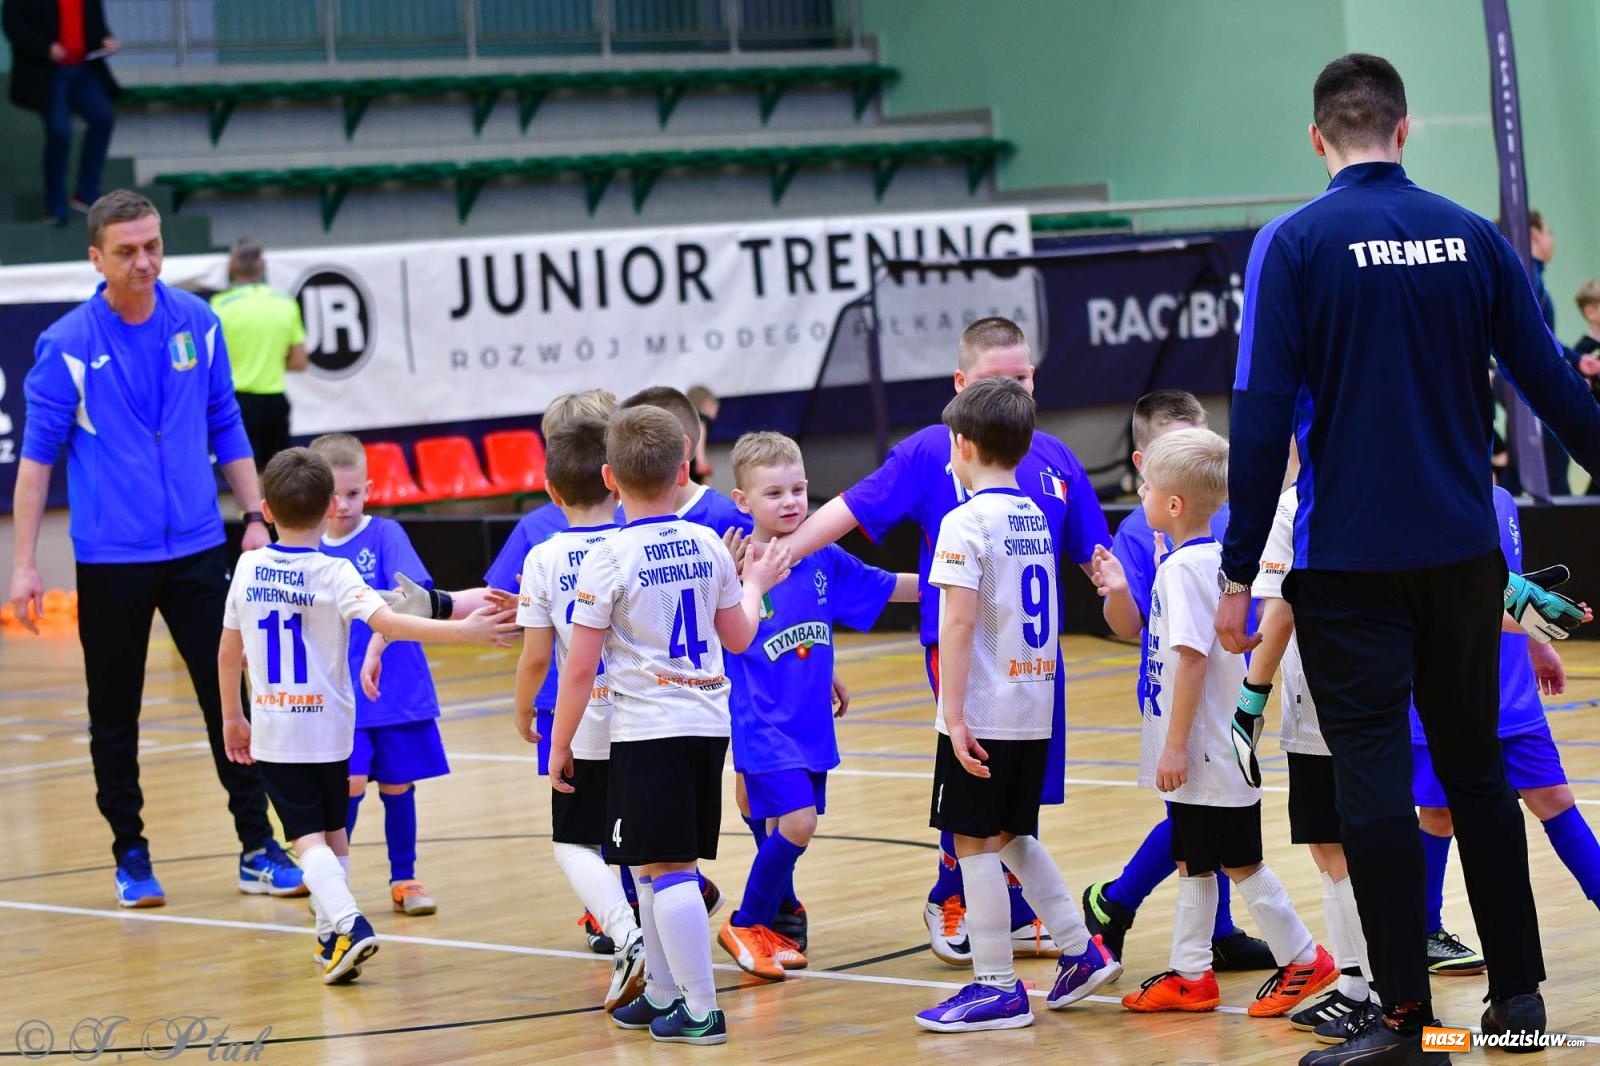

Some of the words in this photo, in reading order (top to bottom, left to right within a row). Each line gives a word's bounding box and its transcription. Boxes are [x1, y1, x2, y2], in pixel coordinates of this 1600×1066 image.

[1348, 237, 1468, 268] TRENER
[449, 243, 714, 319] JUNIOR
[739, 223, 1018, 297] TRENING
[450, 335, 620, 371] ROZWÓJ
[644, 320, 828, 355] MŁODEGO
[1008, 514, 1048, 533] FORTECA
[643, 539, 701, 562] FORTECA
[255, 565, 305, 587] FORTECA
[638, 561, 713, 588] ŚWIERKLANY
[1020, 563, 1051, 649] 9
[668, 588, 709, 670] 4
[767, 624, 829, 655] TYMBARK
[258, 610, 308, 684] 11
[612, 818, 623, 848] 4
